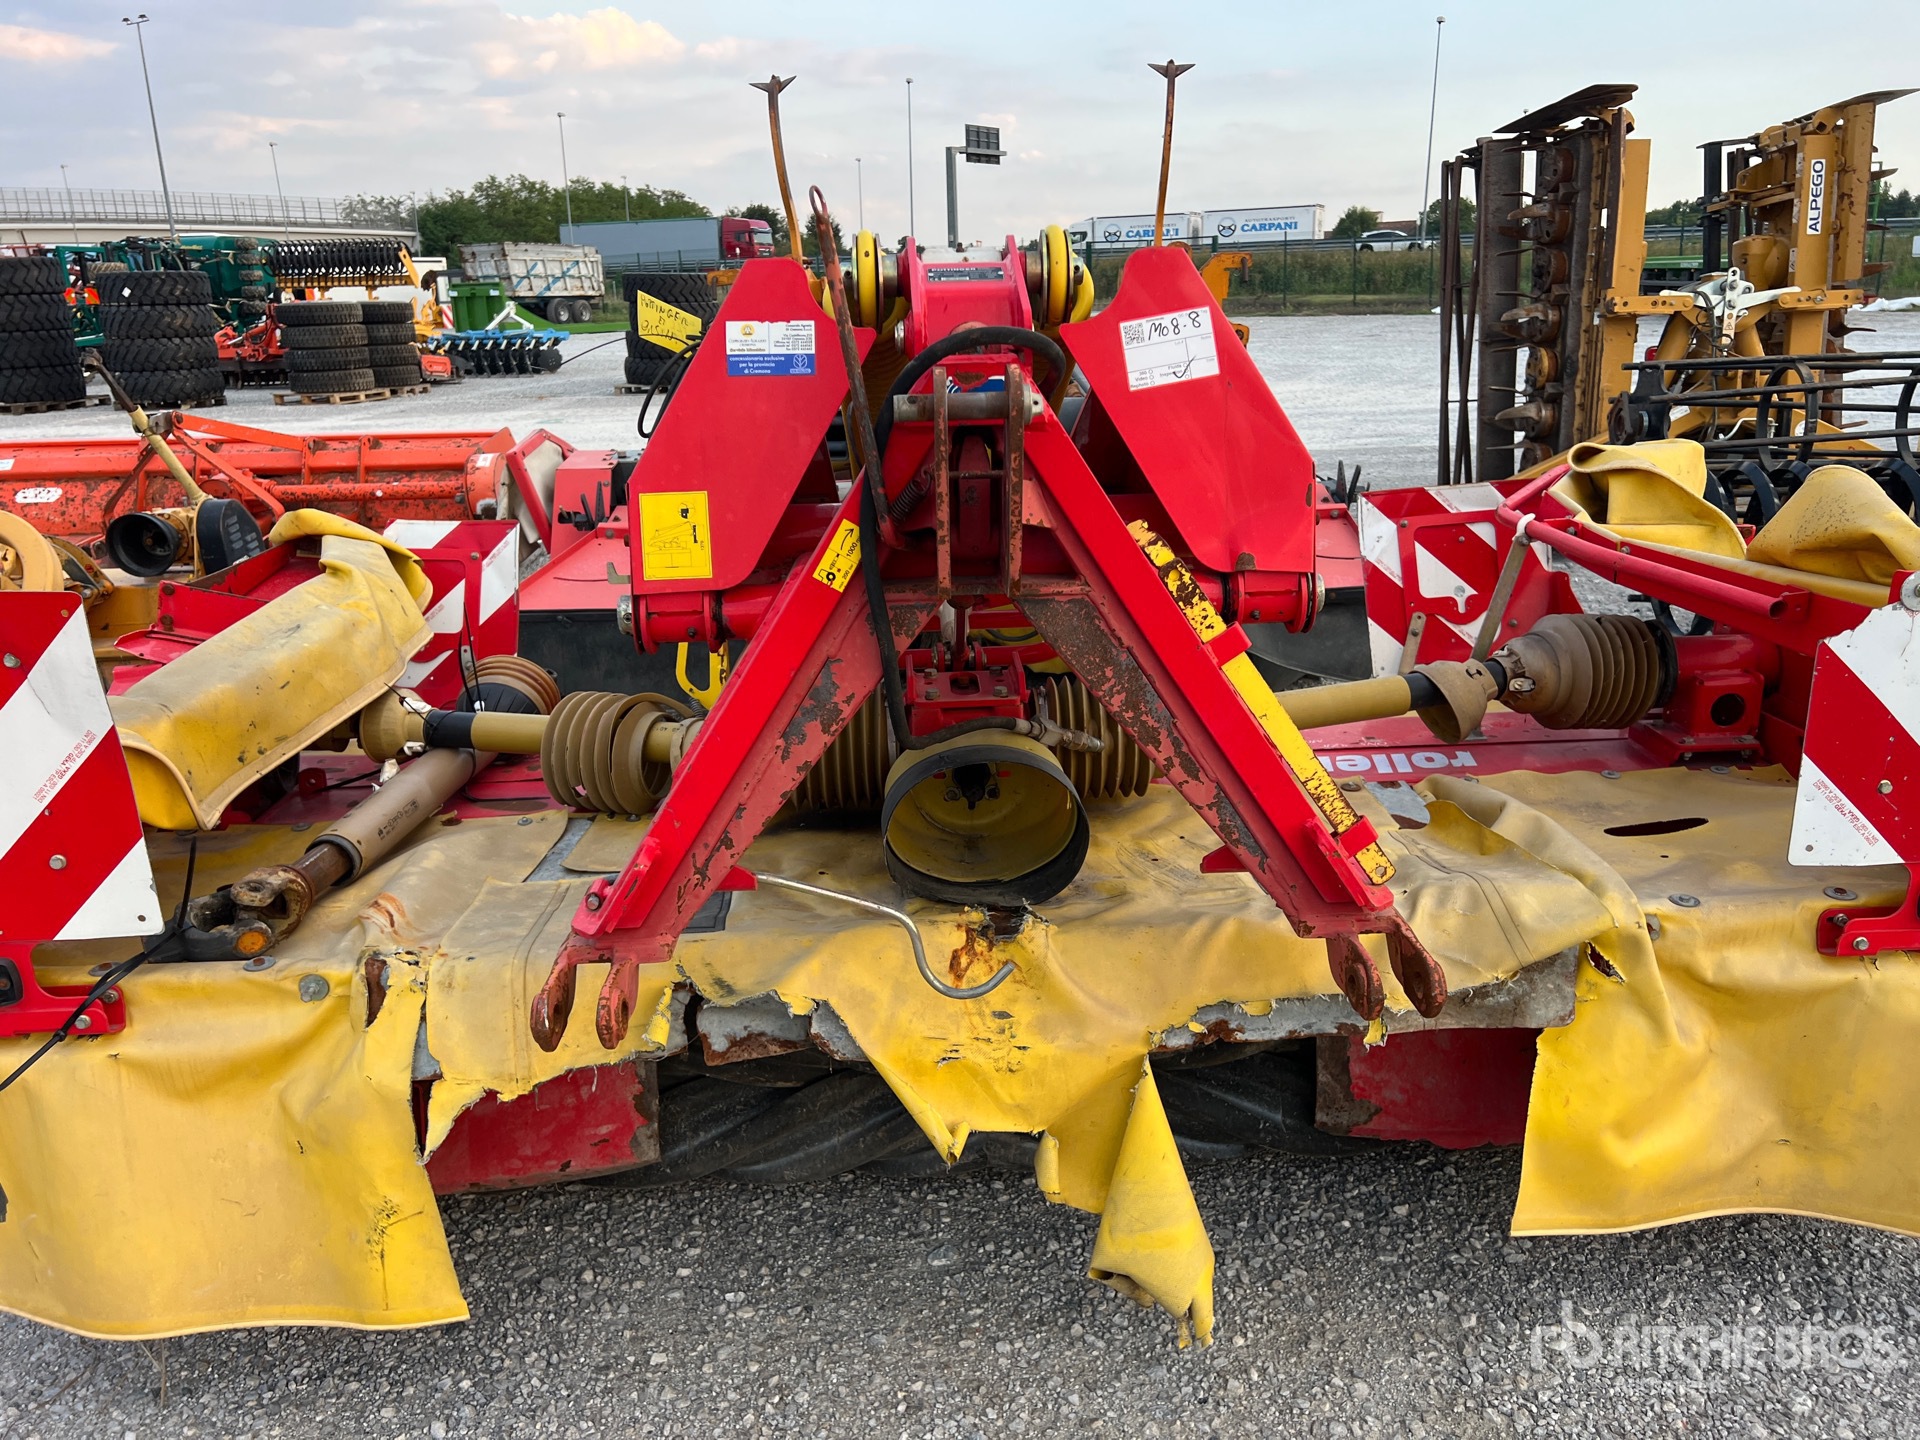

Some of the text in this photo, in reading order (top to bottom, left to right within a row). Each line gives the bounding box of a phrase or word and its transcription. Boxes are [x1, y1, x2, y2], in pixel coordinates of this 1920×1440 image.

[1808, 160, 1824, 232] ALPEGO
[1241, 222, 1298, 232] CARPANI
[847, 542, 857, 557] 1000
[61, 753, 73, 765] GEKA
[58, 767, 70, 779] GEKA
[1835, 804, 1846, 817] GEKA
[1848, 810, 1860, 822] GEKA
